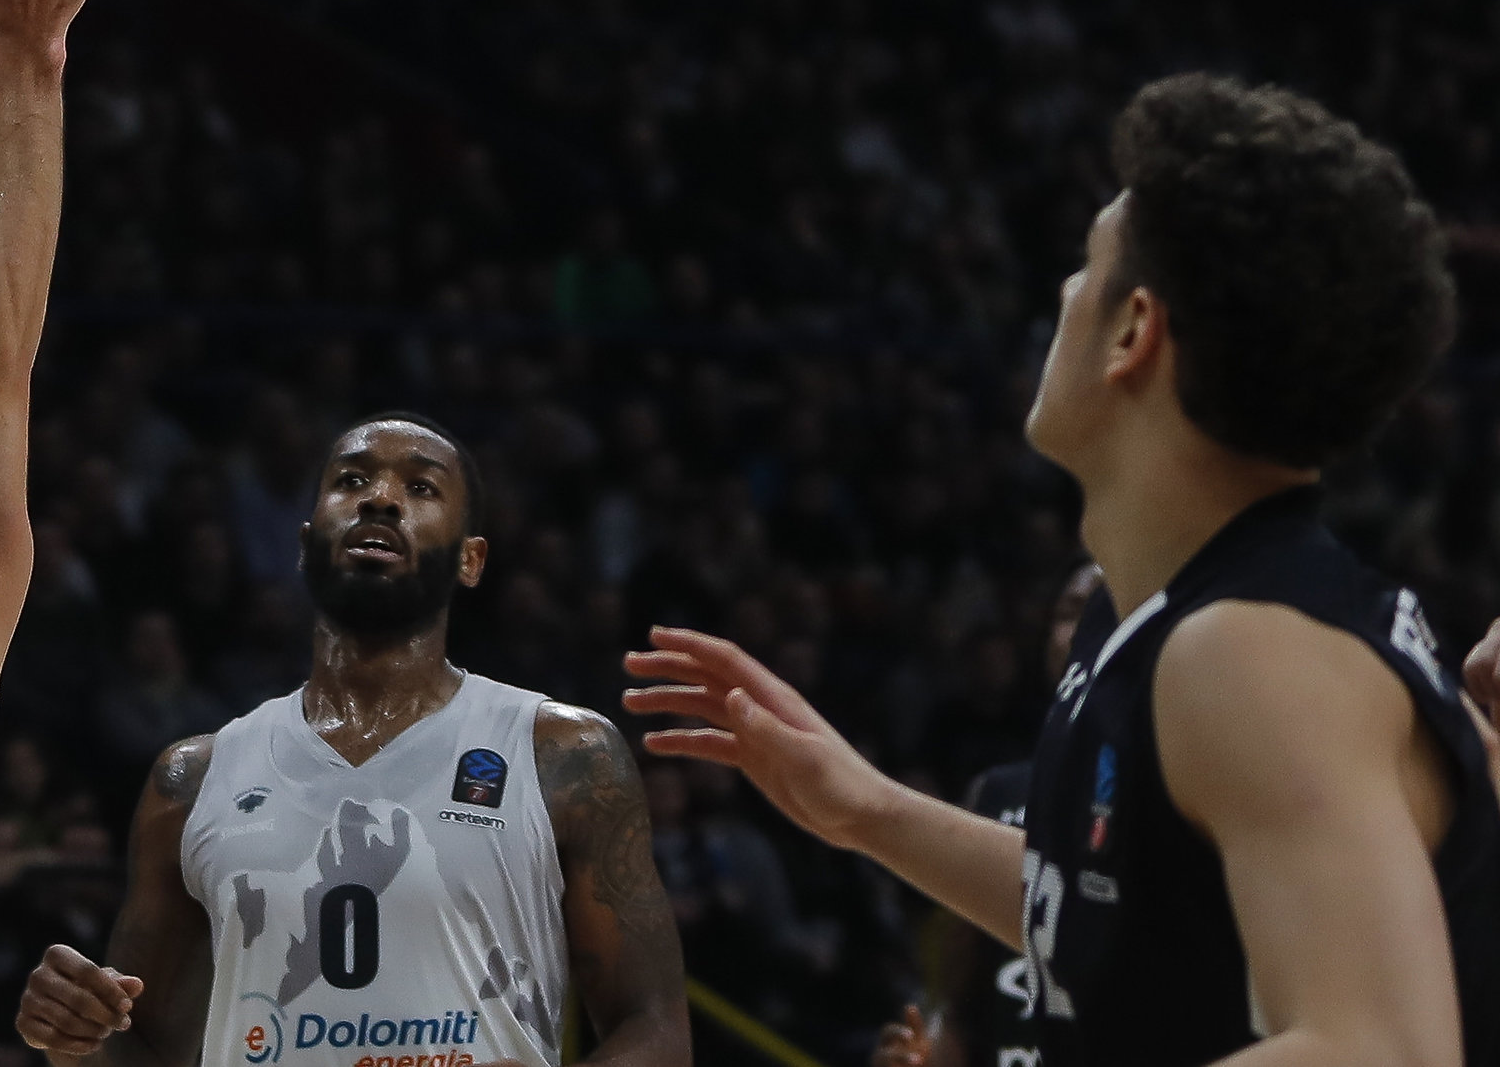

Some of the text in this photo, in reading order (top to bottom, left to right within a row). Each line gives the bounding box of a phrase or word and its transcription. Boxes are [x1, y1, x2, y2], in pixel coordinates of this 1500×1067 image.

[439, 810, 506, 830] oneteam
[319, 883, 380, 990] 0
[295, 1010, 479, 1048] Dolomiti
